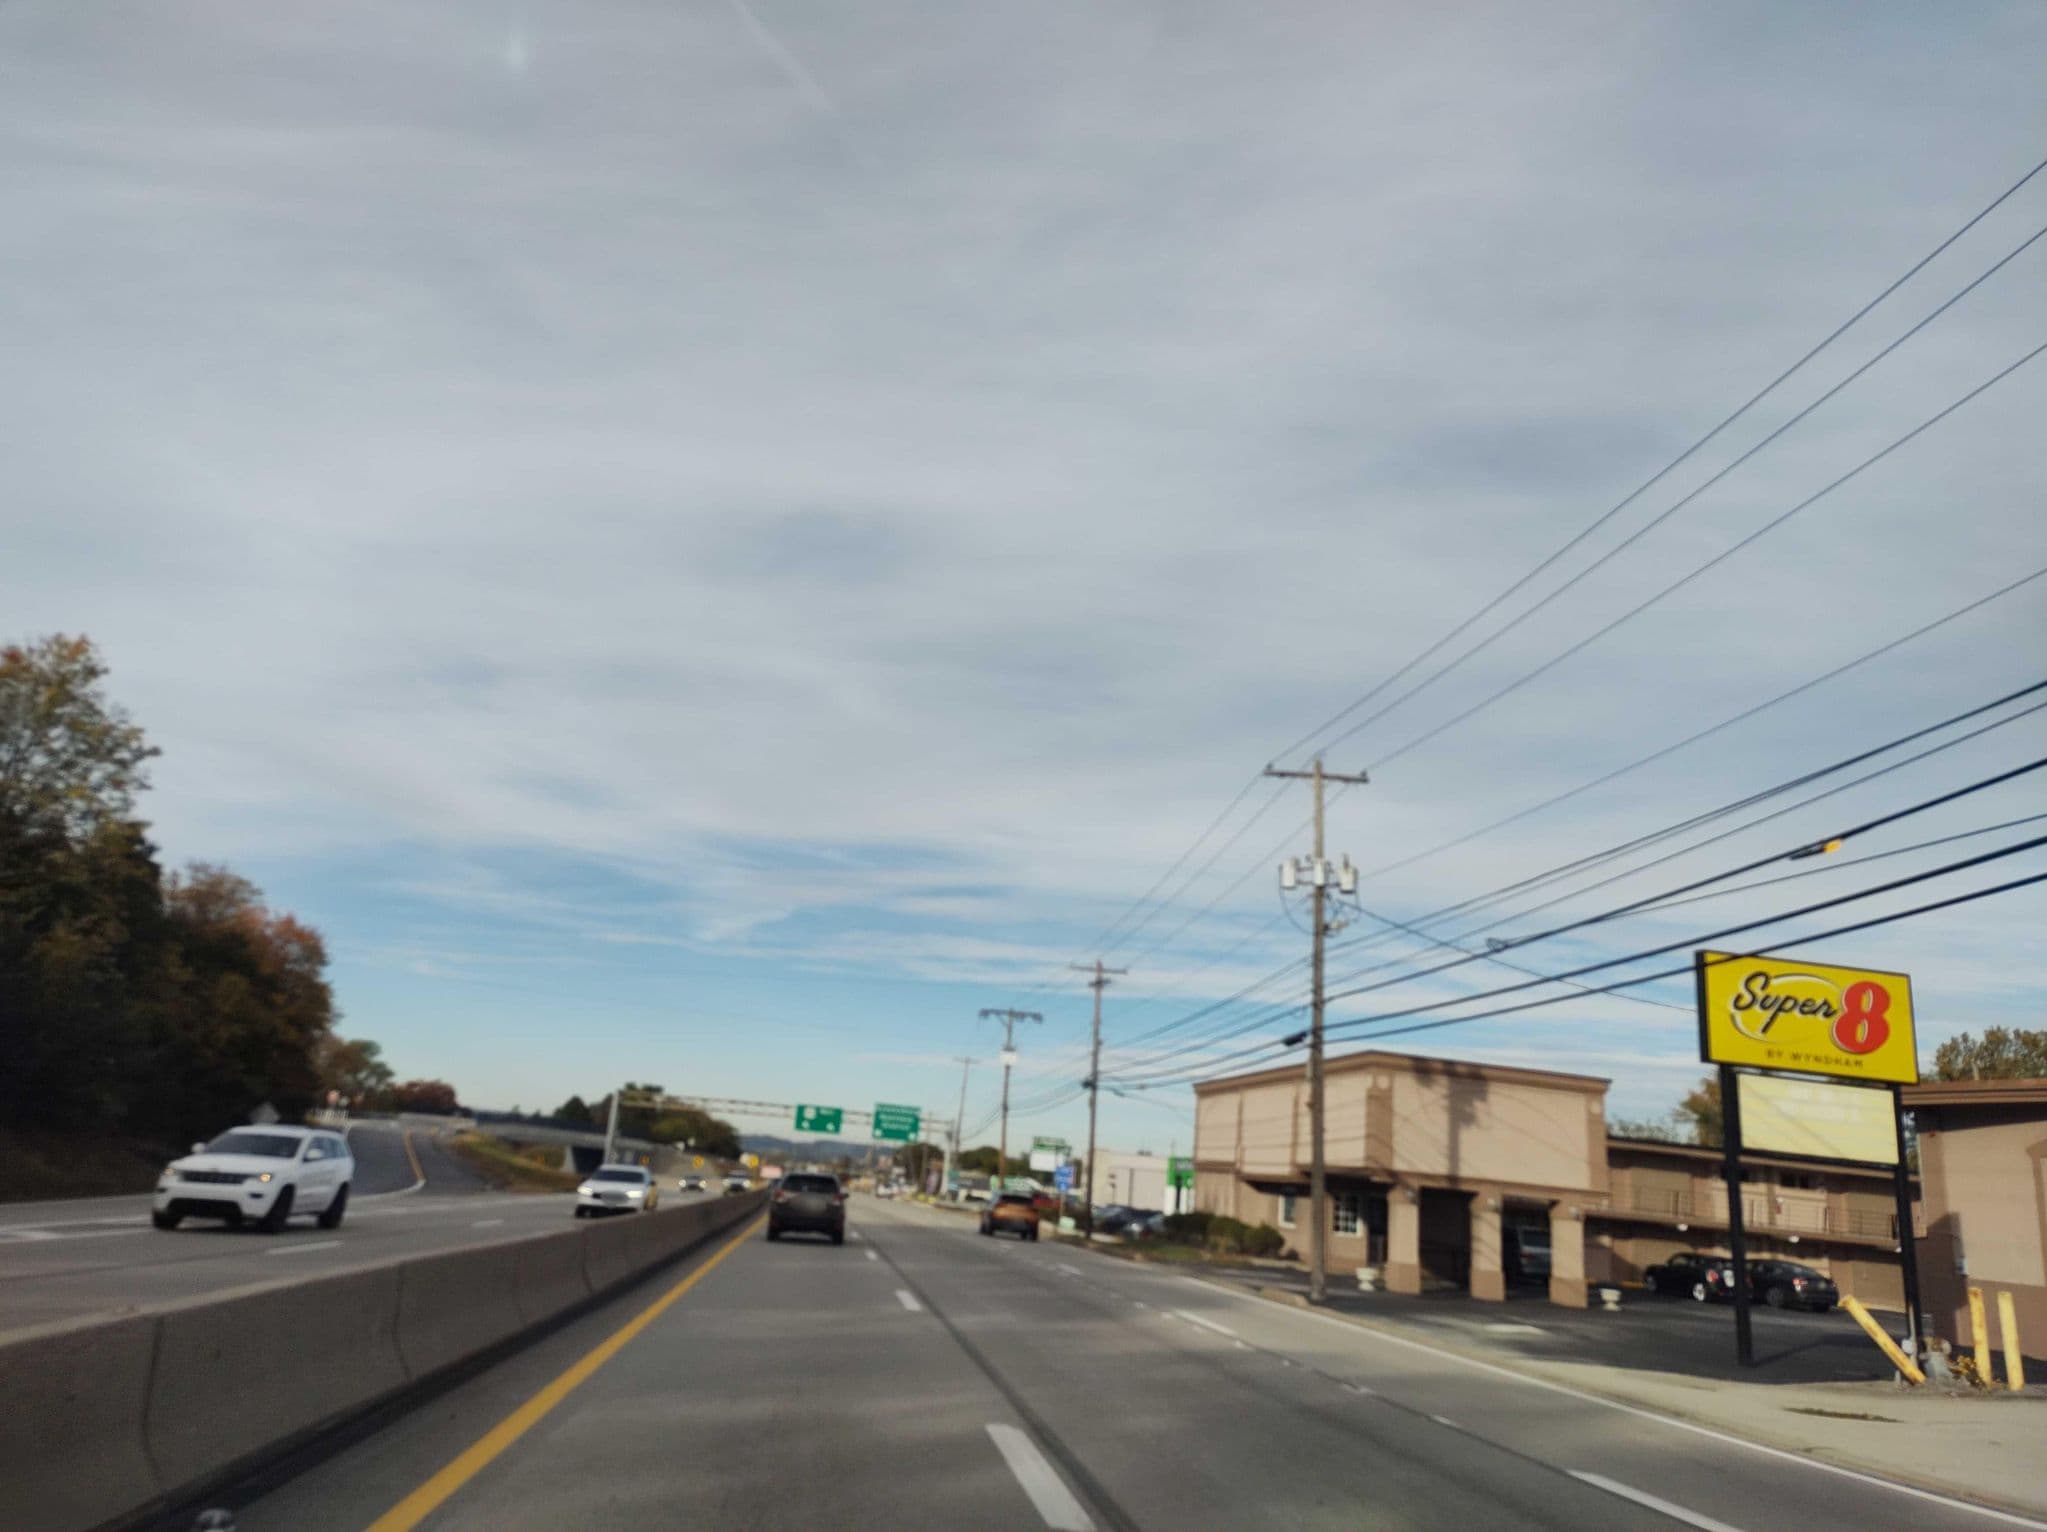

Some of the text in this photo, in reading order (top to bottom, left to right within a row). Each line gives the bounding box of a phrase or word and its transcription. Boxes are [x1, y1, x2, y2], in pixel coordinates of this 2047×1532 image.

[1732, 971, 1891, 1055] Super 8
[1765, 1048, 1864, 1069] BY WYNDHAM
